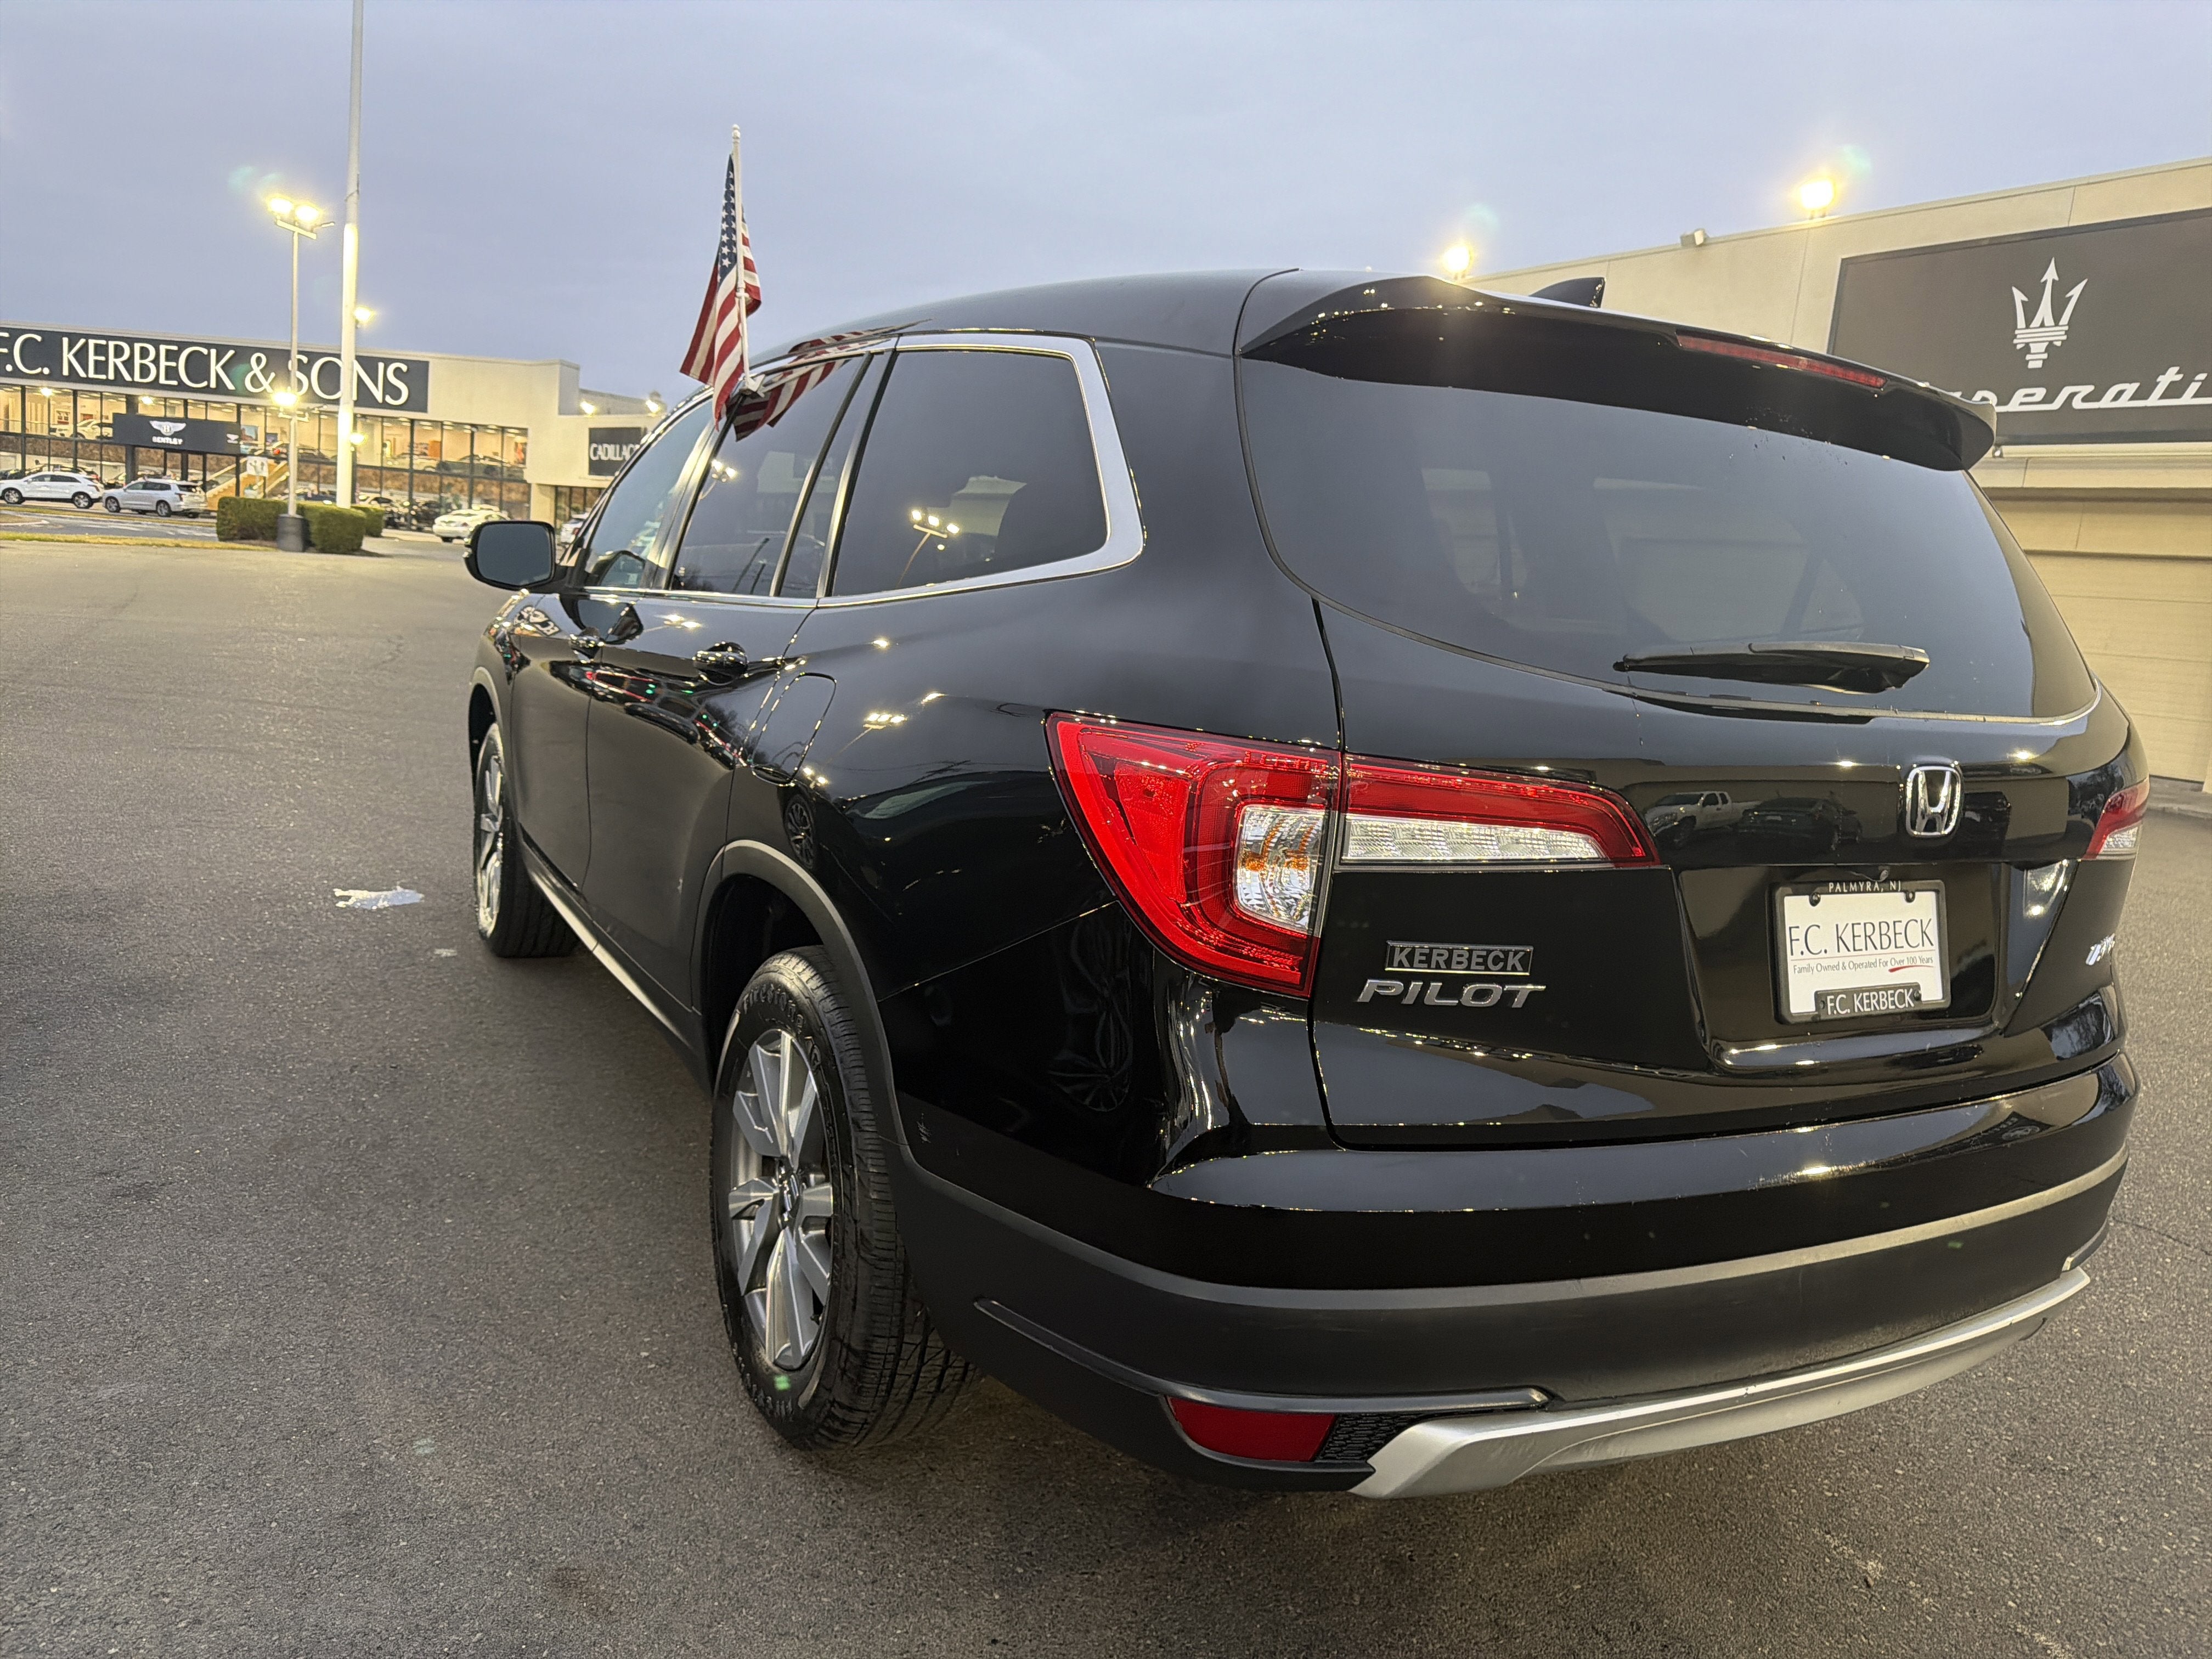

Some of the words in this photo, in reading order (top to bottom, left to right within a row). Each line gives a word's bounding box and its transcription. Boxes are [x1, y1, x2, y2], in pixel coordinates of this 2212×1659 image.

[61, 336, 236, 390] KERBECK
[245, 353, 276, 393] &
[287, 354, 409, 405] SONS
[1829, 881, 1884, 893] PALMYRA,
[1889, 880, 1901, 892] NJ
[1788, 924, 1827, 957] F.C.
[1836, 918, 1934, 953] KERBECK
[1392, 946, 1525, 971] KERBECK
[1793, 963, 1814, 975] Family
[1816, 961, 1840, 973] Owned
[1842, 962, 1847, 970] &
[1848, 958, 1877, 972] Operated
[1878, 958, 1888, 967] For
[1890, 957, 1905, 967] Over
[1906, 956, 1917, 965] 100
[1918, 955, 1933, 964] Years
[1355, 979, 1547, 1008] PILOT
[1827, 994, 1850, 1015] F.C.
[1854, 988, 1915, 1013] KERBECK
